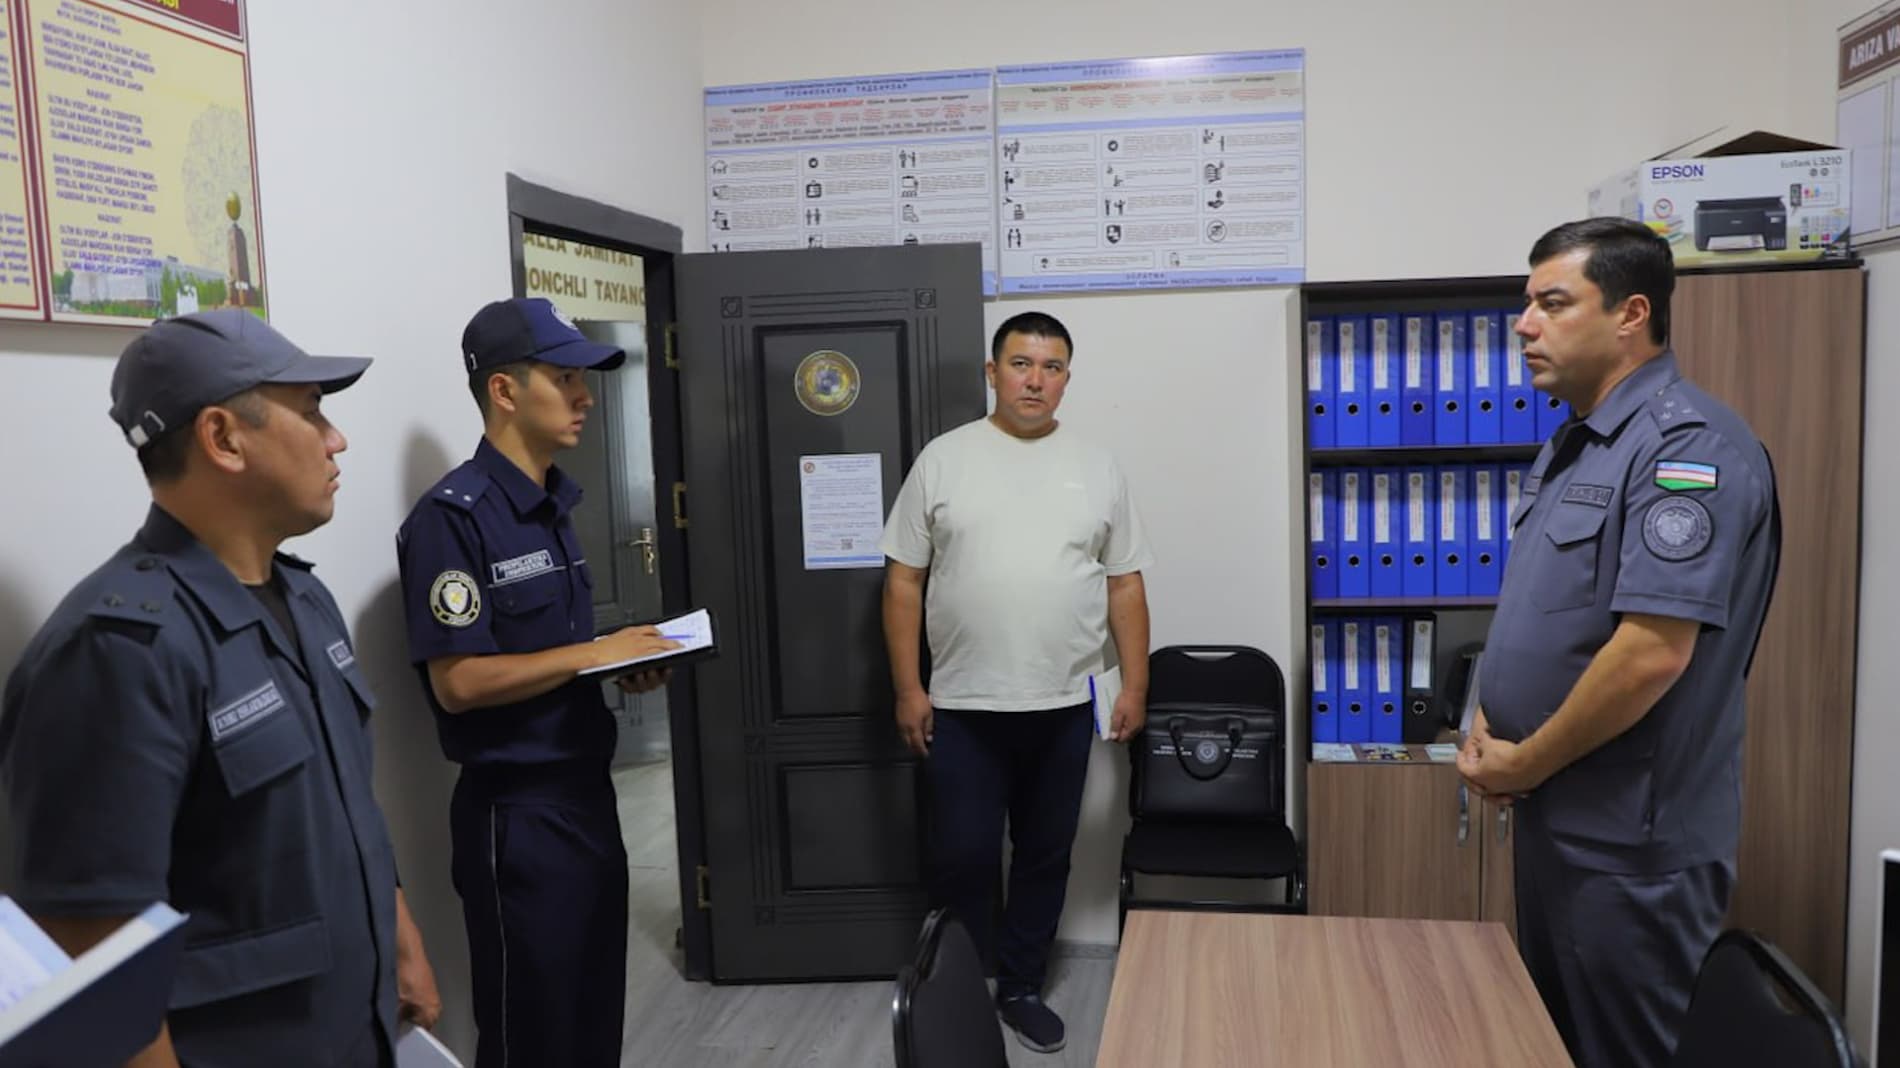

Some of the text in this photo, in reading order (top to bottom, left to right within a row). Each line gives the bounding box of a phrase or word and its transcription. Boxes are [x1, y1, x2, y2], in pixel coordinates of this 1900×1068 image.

[1849, 34, 1884, 70] ARIZA
[1652, 165, 1704, 179] EPSON
[524, 266, 587, 298] ONCHLI
